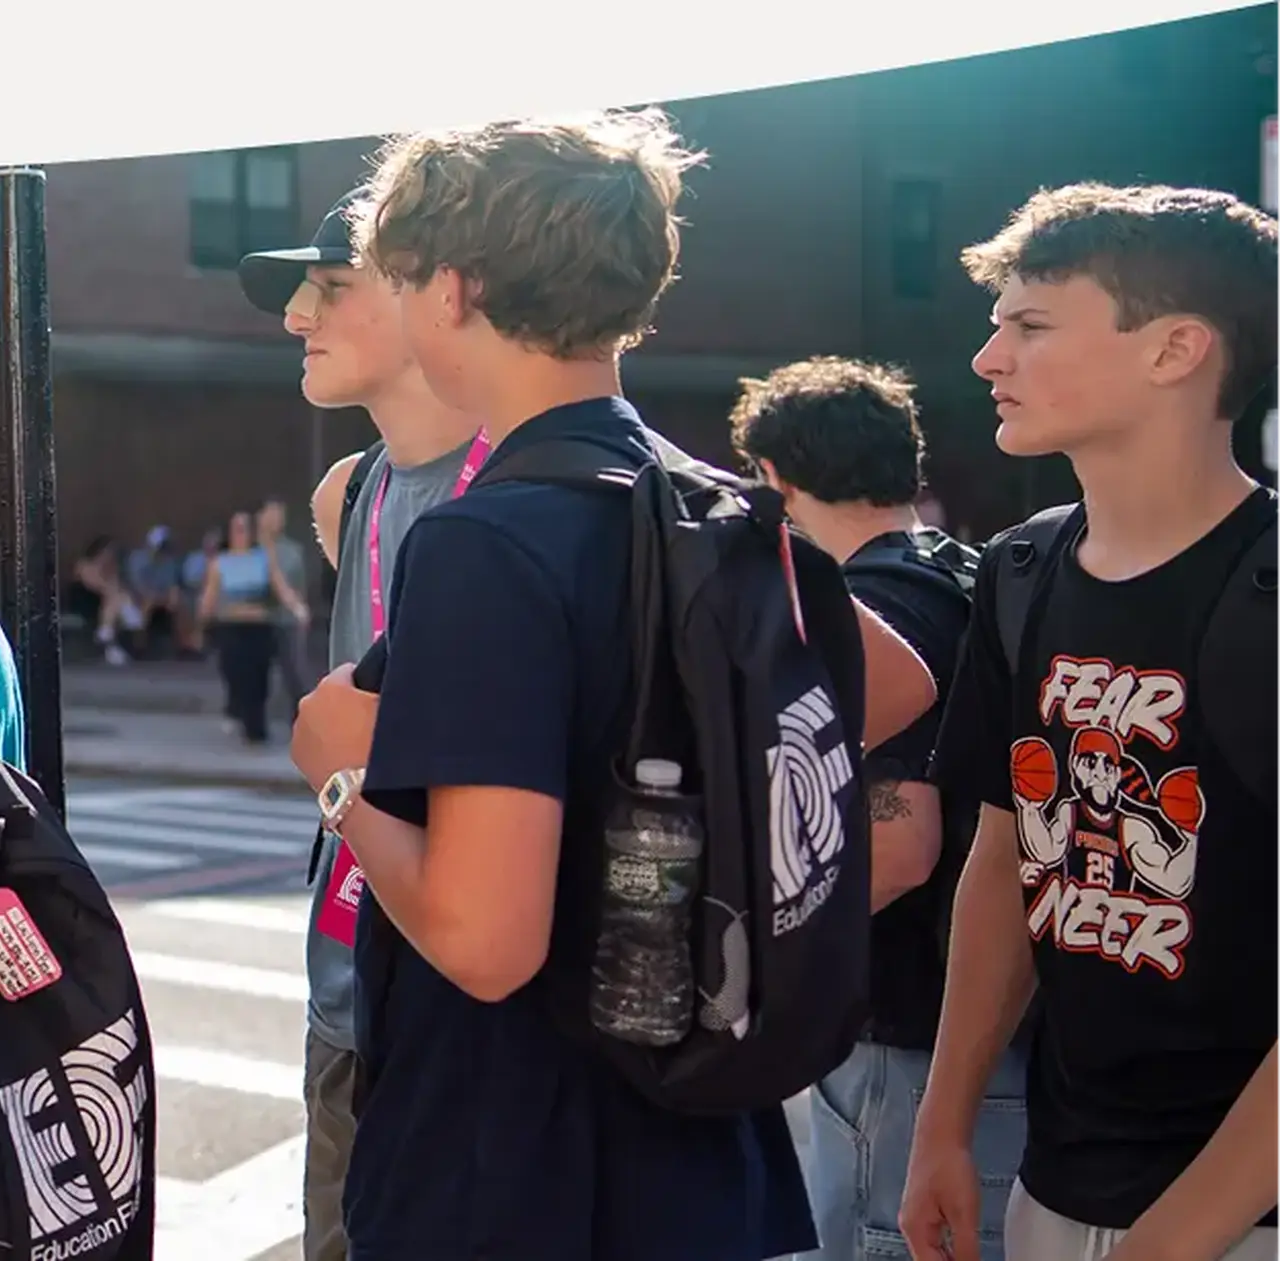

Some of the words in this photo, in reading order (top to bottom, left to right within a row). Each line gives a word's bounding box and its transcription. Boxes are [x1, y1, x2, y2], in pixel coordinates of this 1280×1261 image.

[1041, 657, 1185, 748] FEAR
[1087, 851, 1114, 890] 25
[1028, 878, 1191, 976] NEER
[31, 1218, 122, 1261] Education
